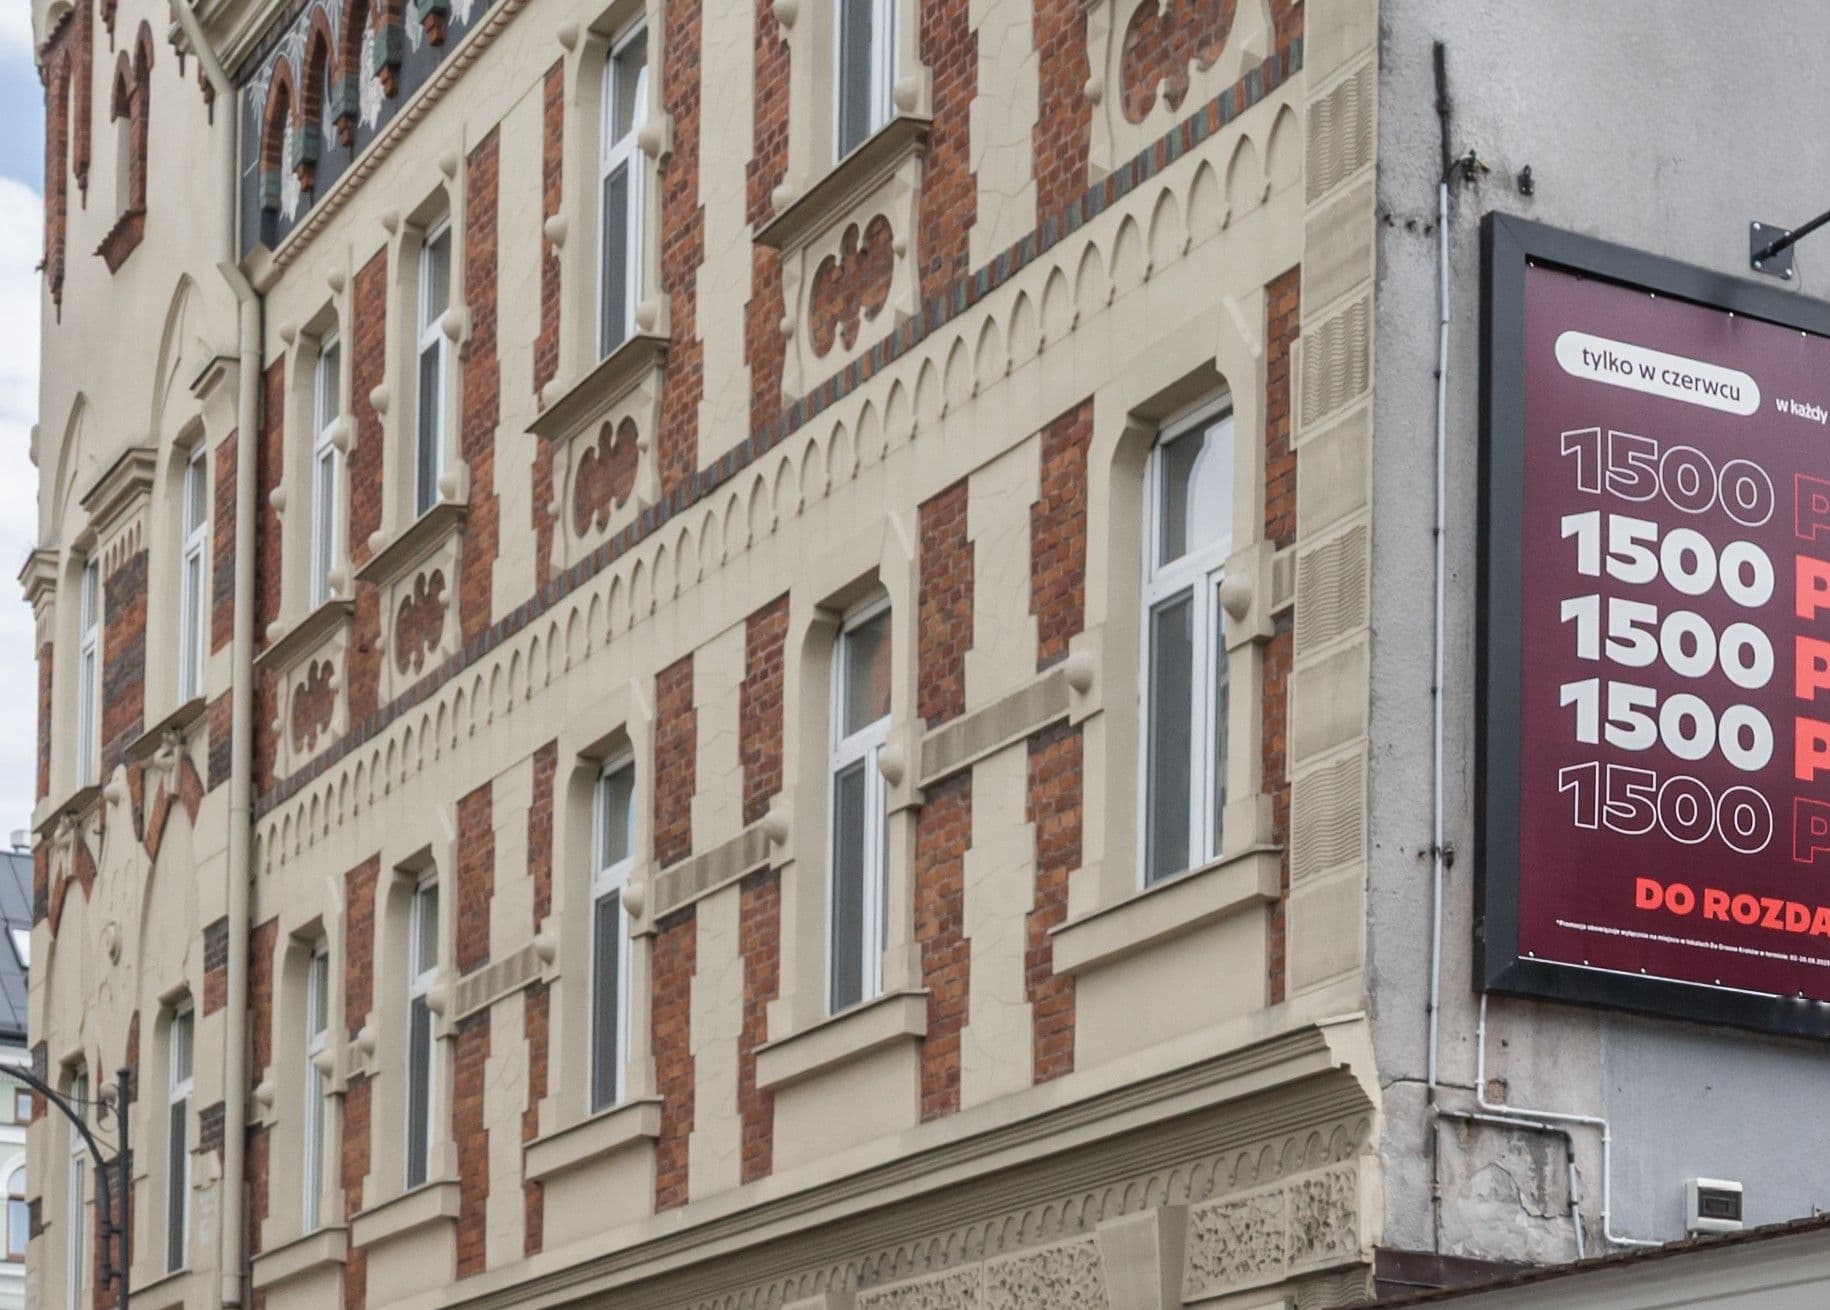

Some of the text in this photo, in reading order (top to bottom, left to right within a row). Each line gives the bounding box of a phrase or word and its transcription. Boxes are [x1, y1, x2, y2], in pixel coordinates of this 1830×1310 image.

[1582, 346, 1741, 402] tylko w czerwcu
[1776, 398, 1789, 412] w
[1790, 399, 1828, 425] każdy
[1561, 427, 1775, 527] 1500
[1560, 510, 1775, 608] 1500
[1560, 594, 1775, 689] 1500
[1559, 678, 1774, 771] 1500
[1558, 761, 1774, 854] 1500
[1635, 877, 1696, 914] DO
